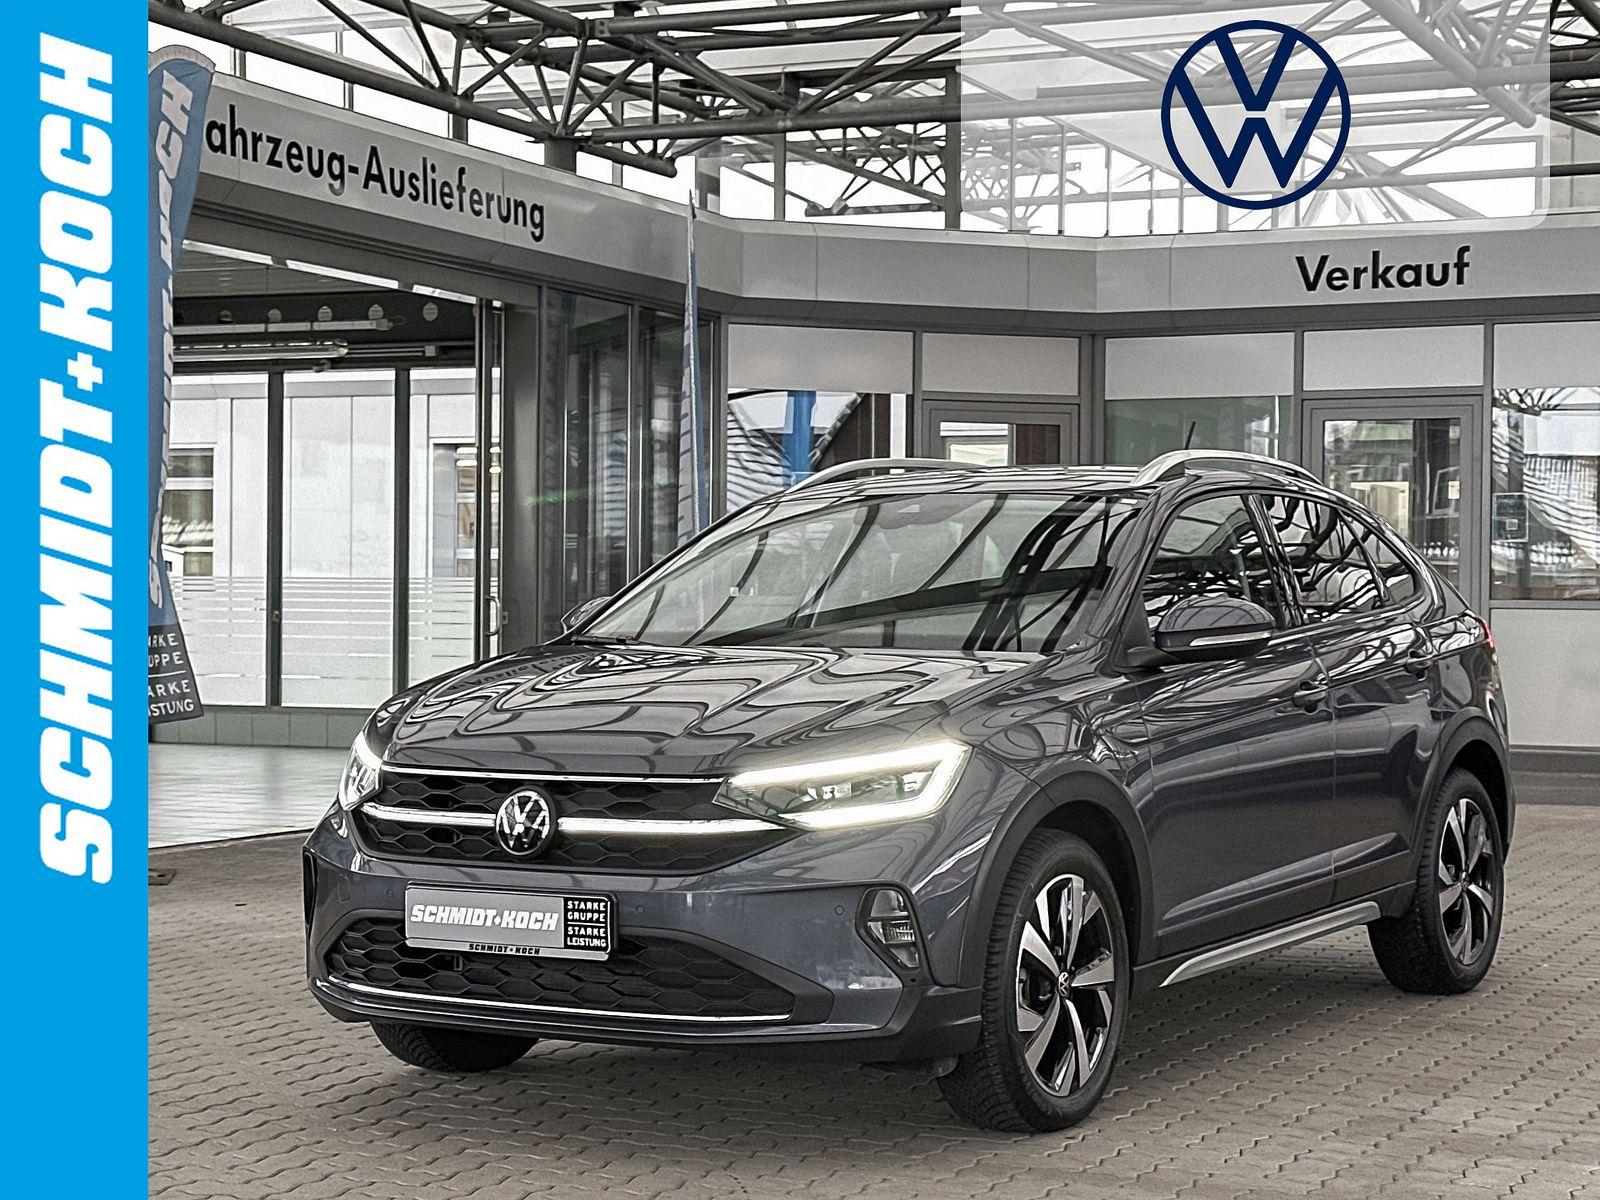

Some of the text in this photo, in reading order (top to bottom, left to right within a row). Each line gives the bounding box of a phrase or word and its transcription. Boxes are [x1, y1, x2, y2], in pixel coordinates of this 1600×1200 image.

[205, 104, 546, 243] ahrzeug-Auslieferung
[1295, 245, 1471, 292] Verkauf
[148, 651, 184, 668] UPPE
[148, 679, 191, 698] ARKE
[567, 900, 606, 911] STARKE
[567, 911, 606, 922] GRUPPE
[567, 926, 606, 937] STARKE
[567, 936, 607, 948] LEISTUNG
